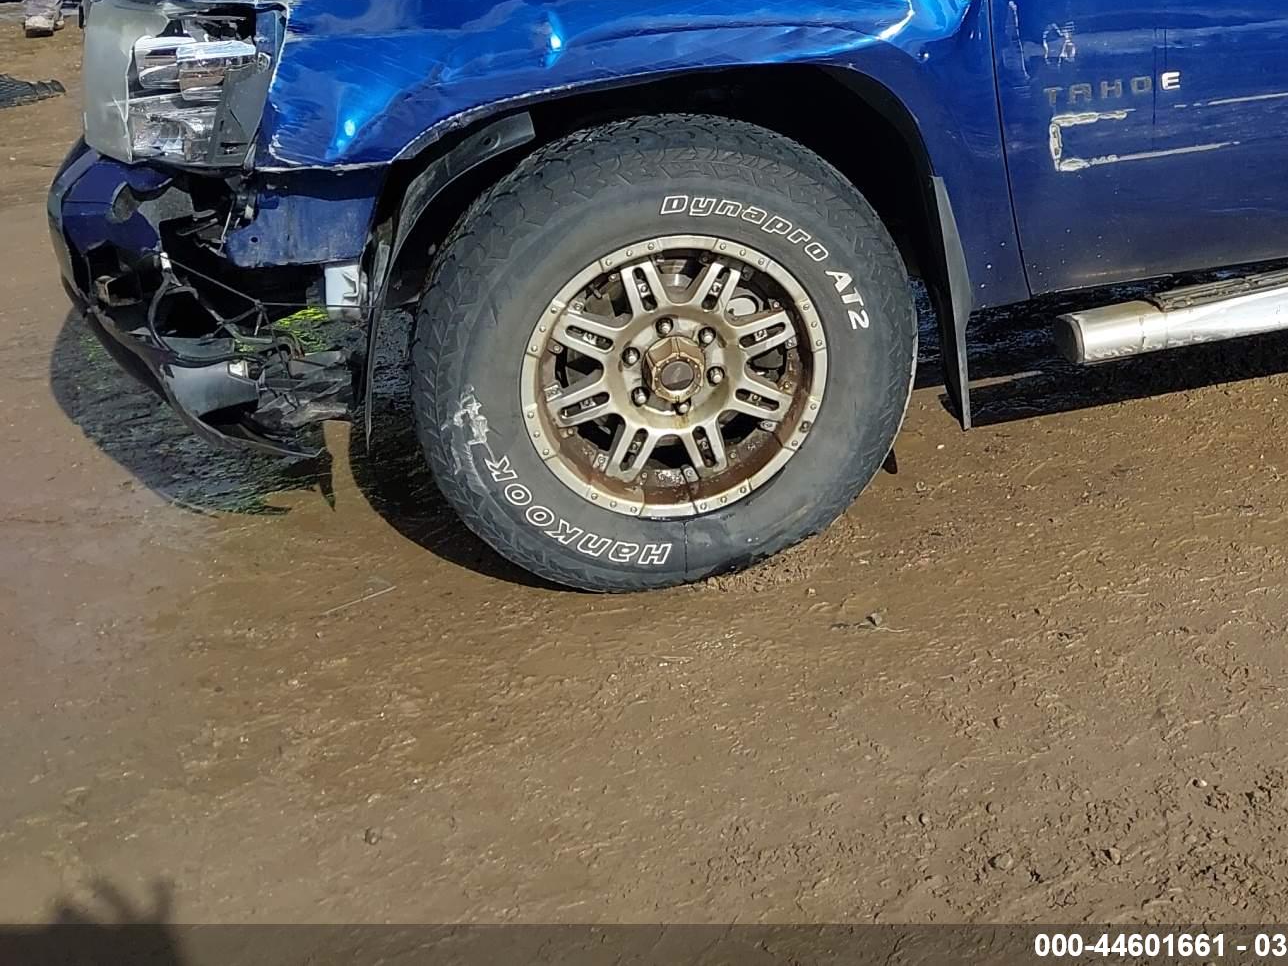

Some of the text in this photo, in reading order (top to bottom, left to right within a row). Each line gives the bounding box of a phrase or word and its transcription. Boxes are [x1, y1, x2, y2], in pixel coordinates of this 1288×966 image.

[1043, 71, 1182, 107] TAHOE
[660, 195, 870, 330] Dynapro AT2
